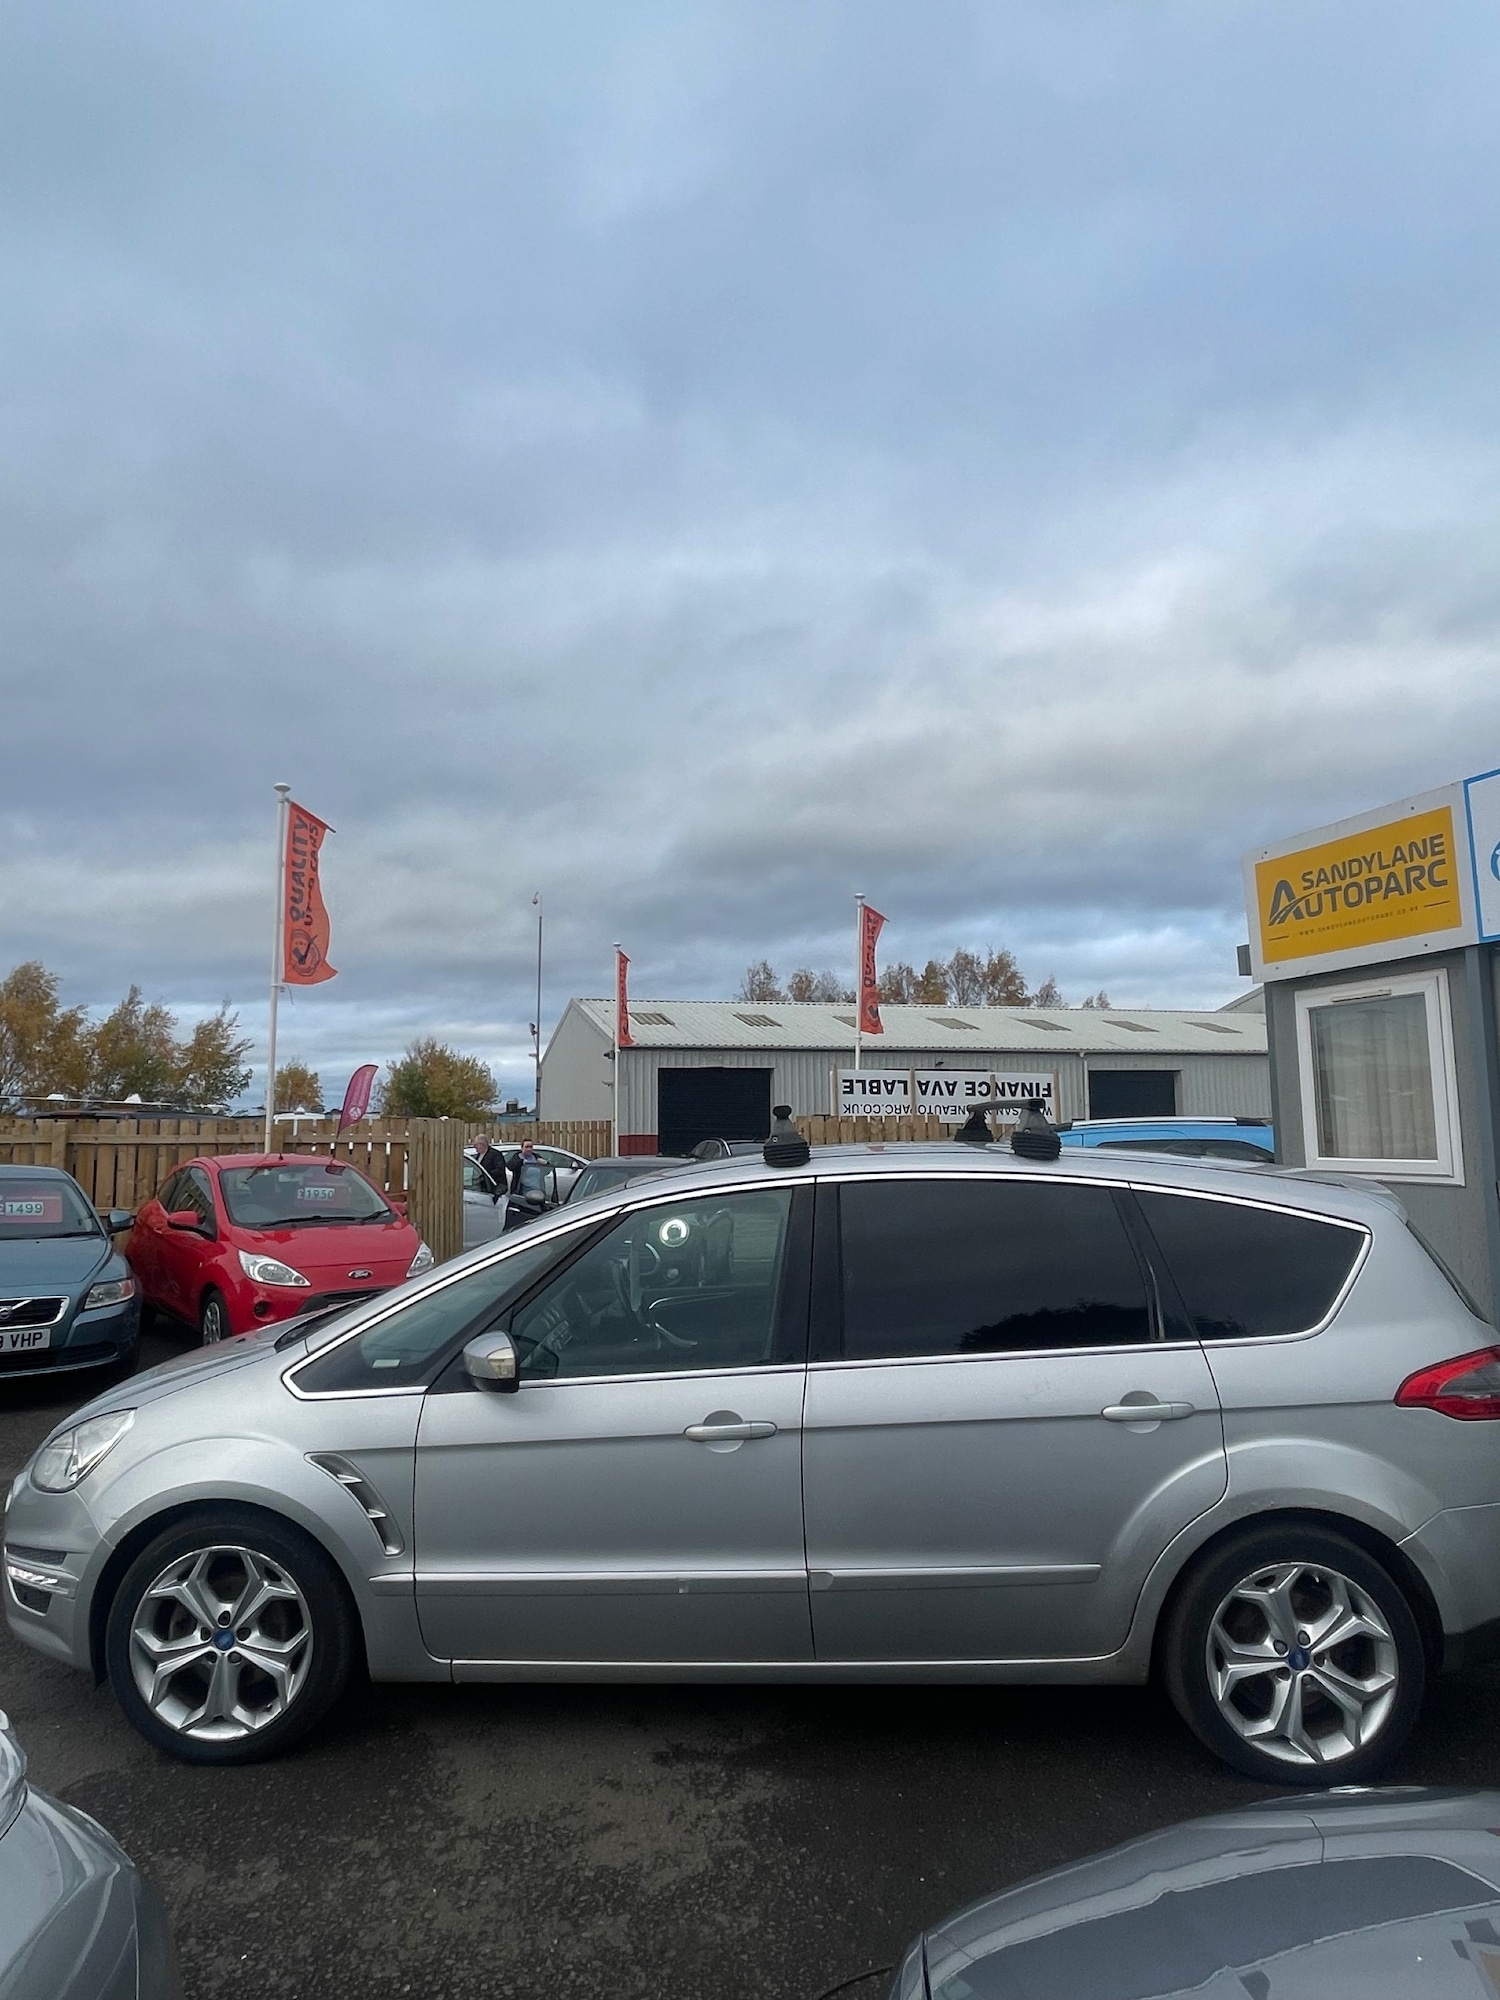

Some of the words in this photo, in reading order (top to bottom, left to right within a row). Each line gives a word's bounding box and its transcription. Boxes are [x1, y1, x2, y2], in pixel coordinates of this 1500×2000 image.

[309, 822, 319, 873] CARS
[1302, 833, 1445, 891] SANDYLANE
[289, 815, 308, 922] QUALITY
[1268, 858, 1448, 926] AUTOPARC
[842, 1079, 956, 1096] AVALABLE
[965, 1081, 1052, 1098] FINANCE
[297, 1188, 334, 1199] £1950
[11, 1332, 42, 1348] VHP
